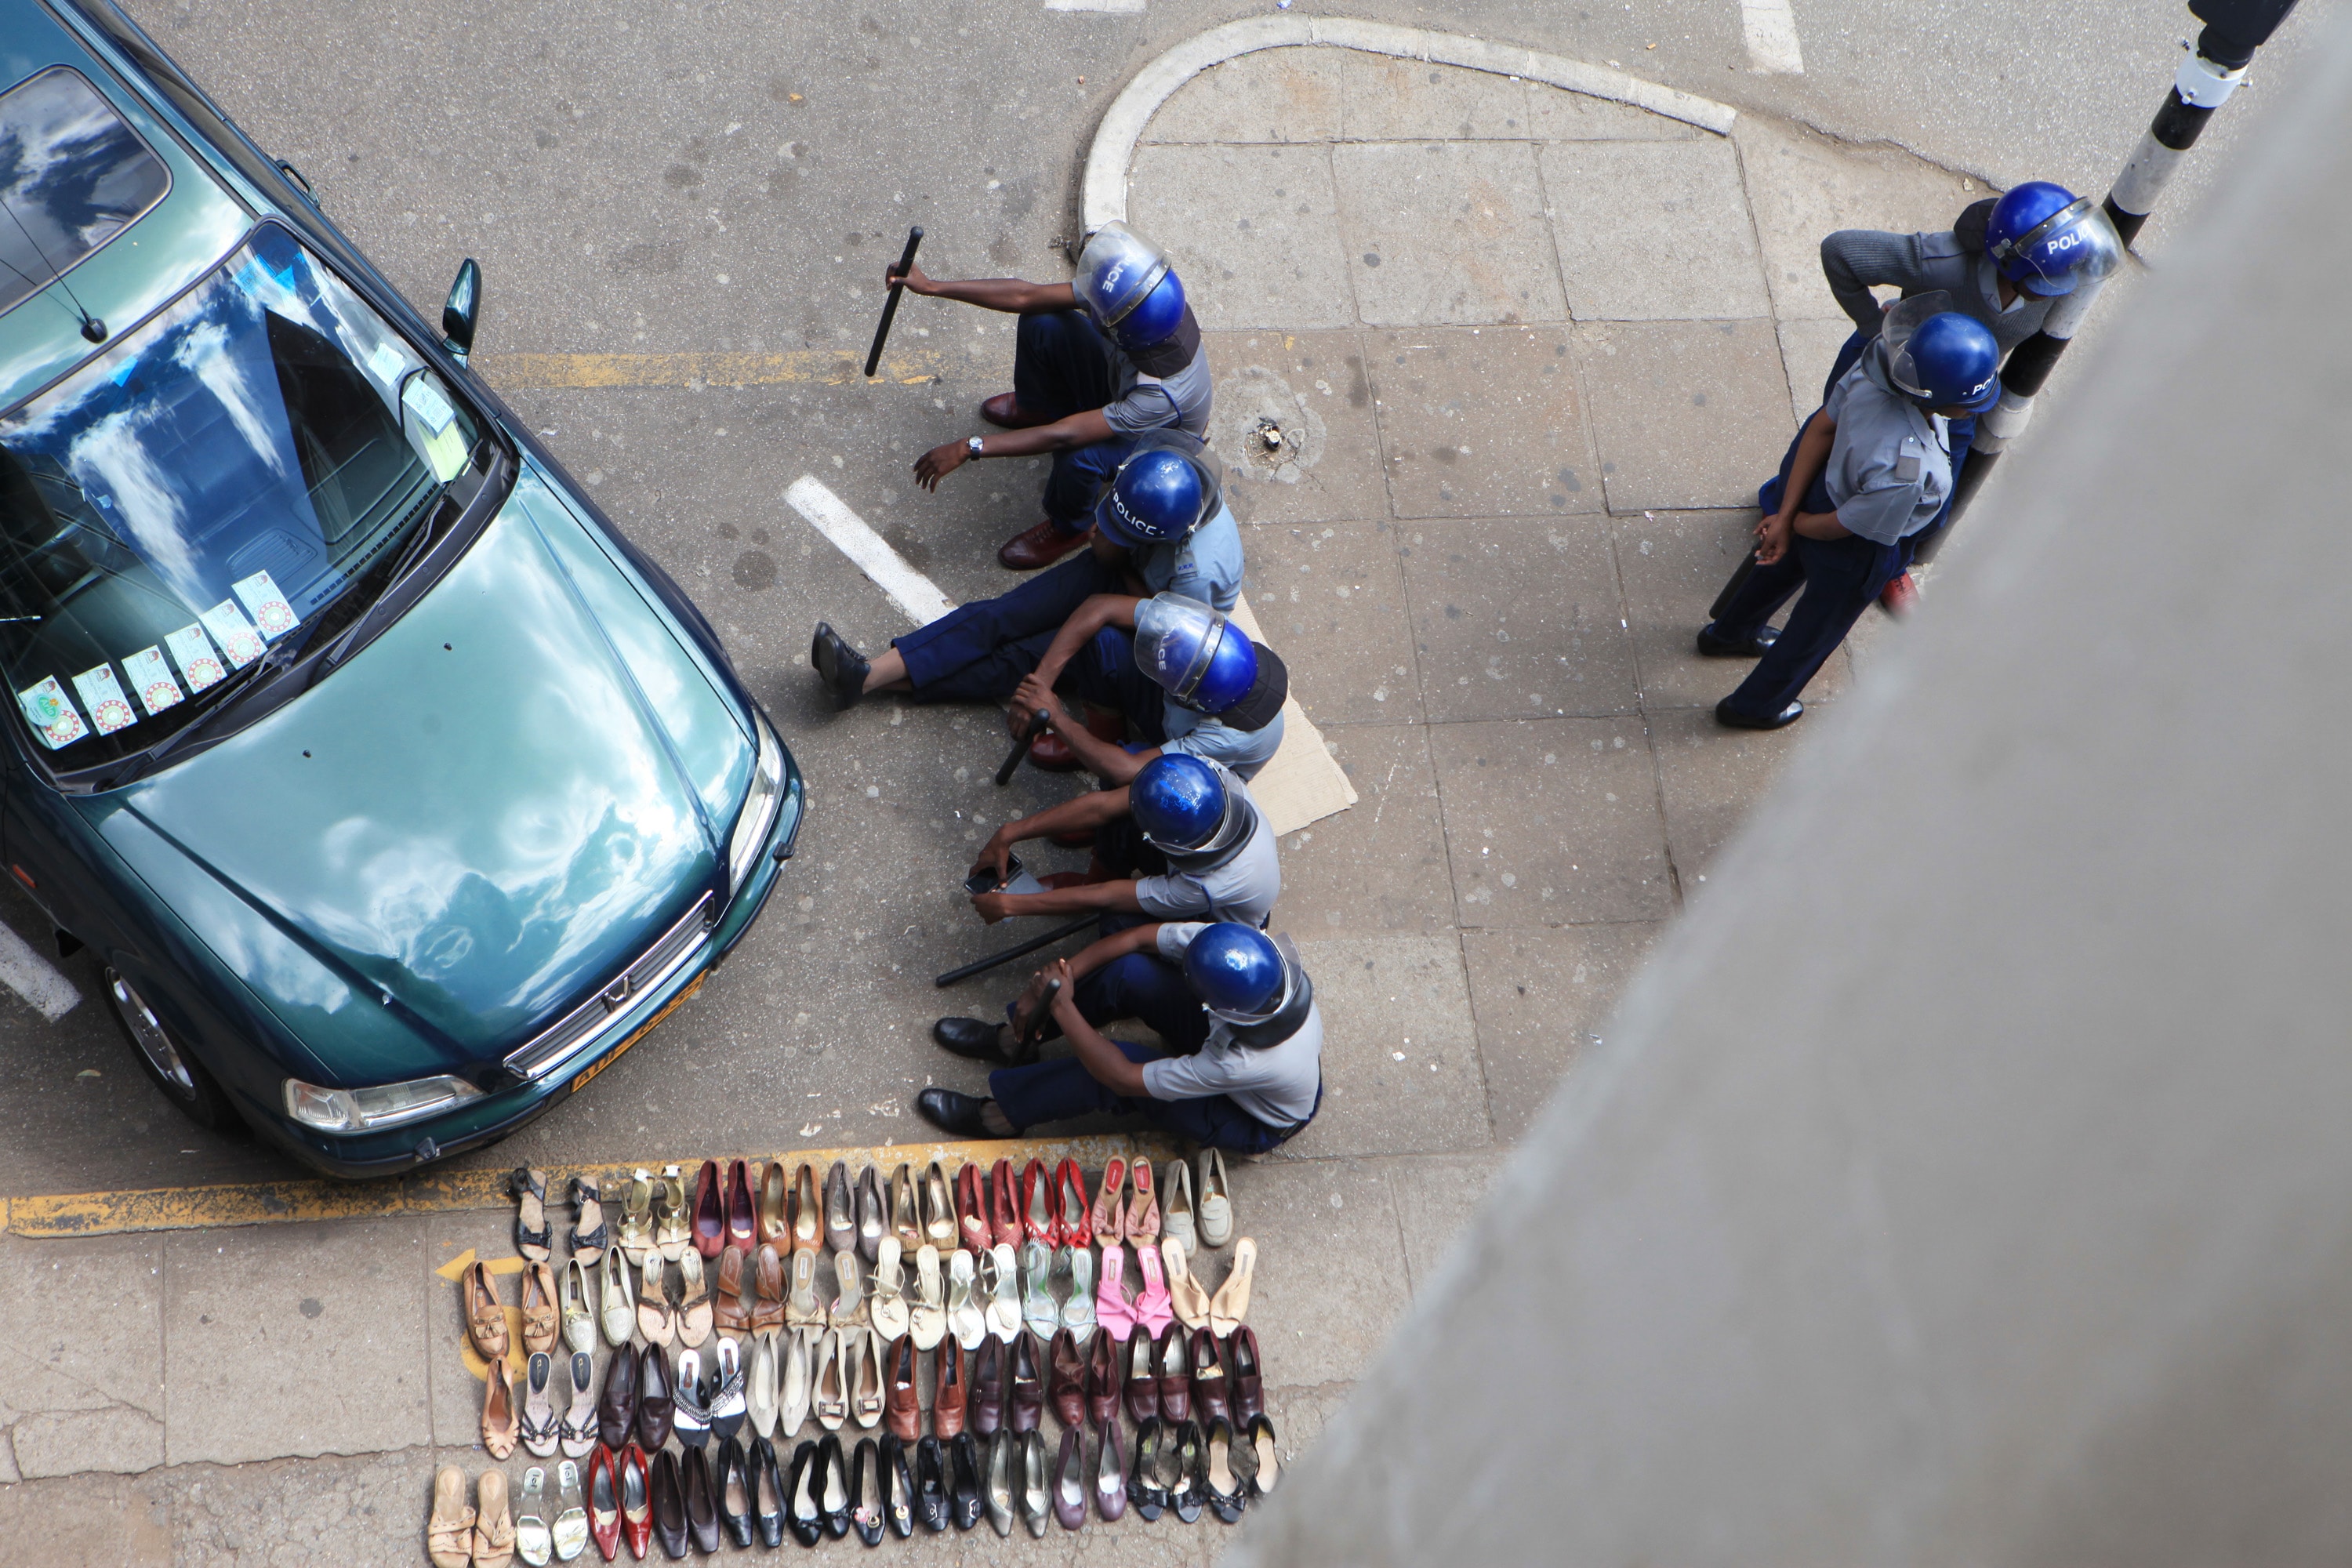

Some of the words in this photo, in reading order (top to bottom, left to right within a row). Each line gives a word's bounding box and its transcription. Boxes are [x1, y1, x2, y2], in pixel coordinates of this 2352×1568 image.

[2047, 223, 2090, 255] POLIC
[1102, 253, 1137, 292] OLICE
[1113, 492, 1157, 535] POLICE
[1158, 625, 1176, 670] OLICE
